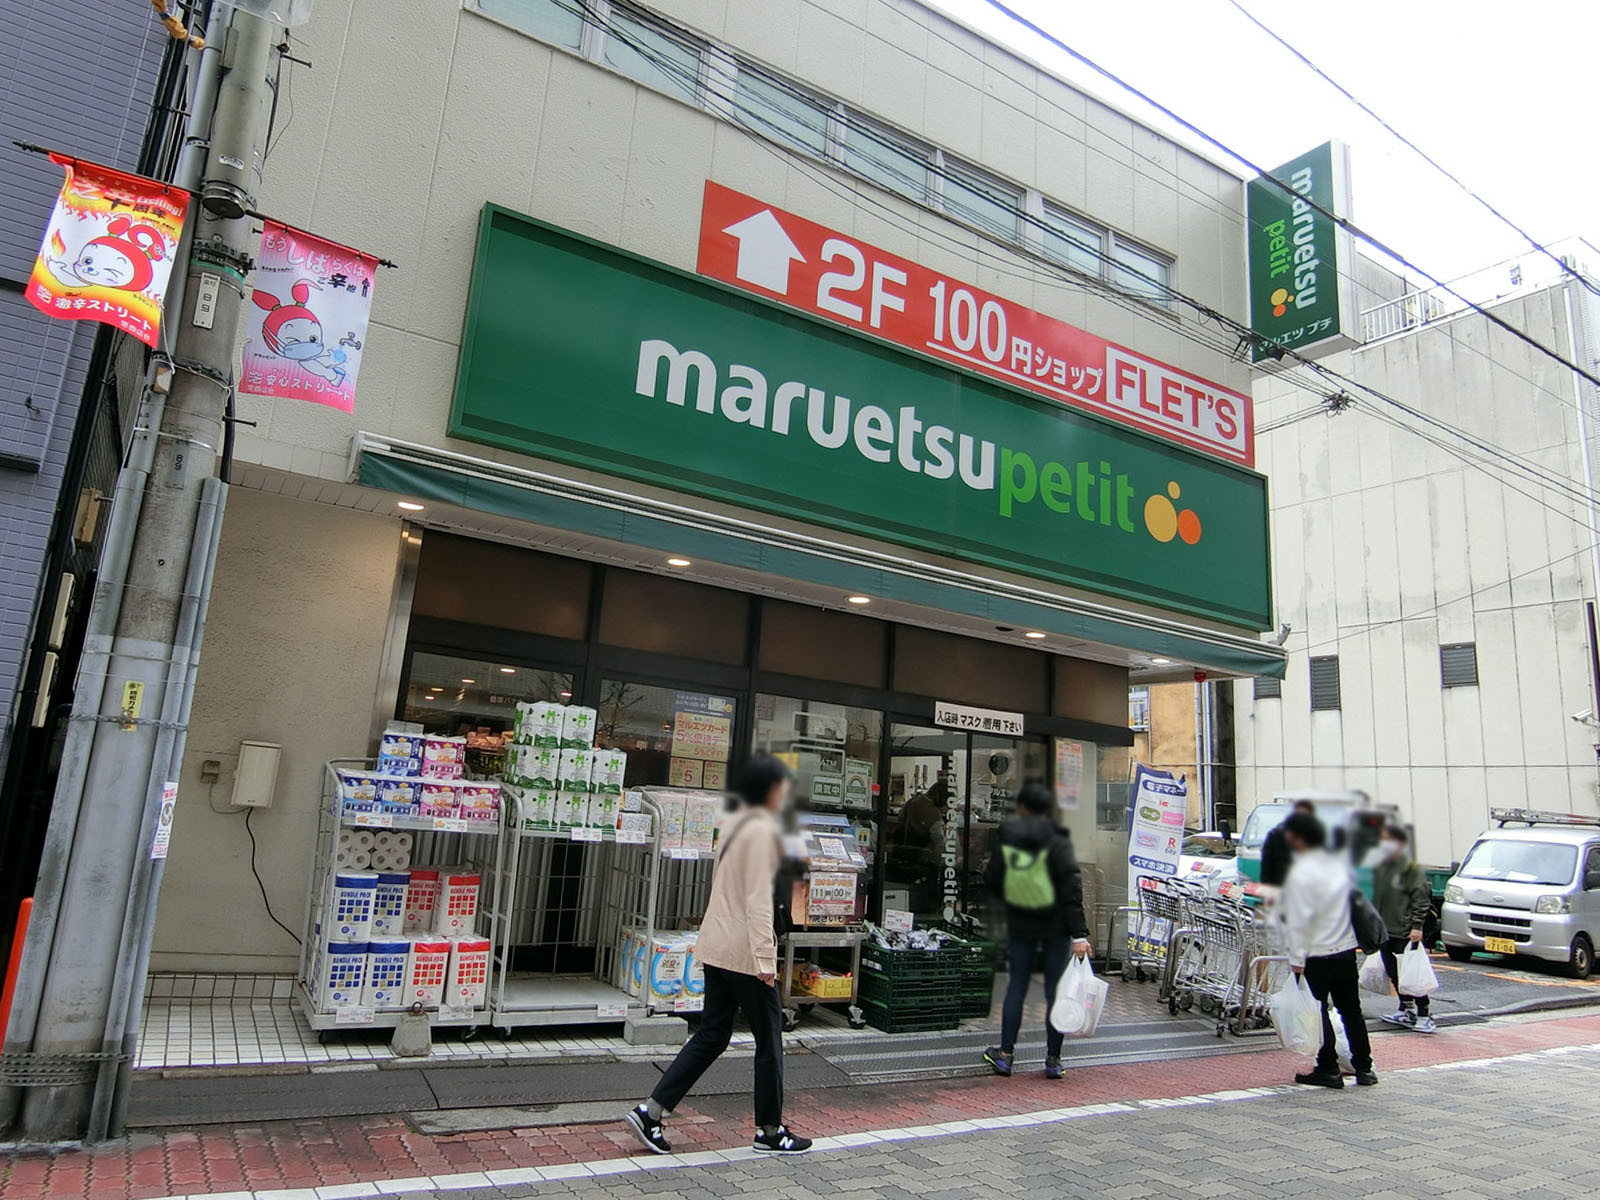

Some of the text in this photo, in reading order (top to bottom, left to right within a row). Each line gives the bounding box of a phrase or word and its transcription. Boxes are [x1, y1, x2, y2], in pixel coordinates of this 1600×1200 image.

[1263, 218, 1292, 279] petit
[1291, 166, 1319, 310] maruetsu
[816, 238, 908, 330] 2F
[928, 279, 1104, 397] 100円ショップ
[1115, 352, 1239, 441] FLET'S
[634, 338, 1135, 533] maruetsu petit
[937, 709, 1022, 733] 入店時 マスク 着用 下さい
[683, 769, 693, 783] 5
[711, 774, 720, 785] 2
[779, 1136, 794, 1149] N
